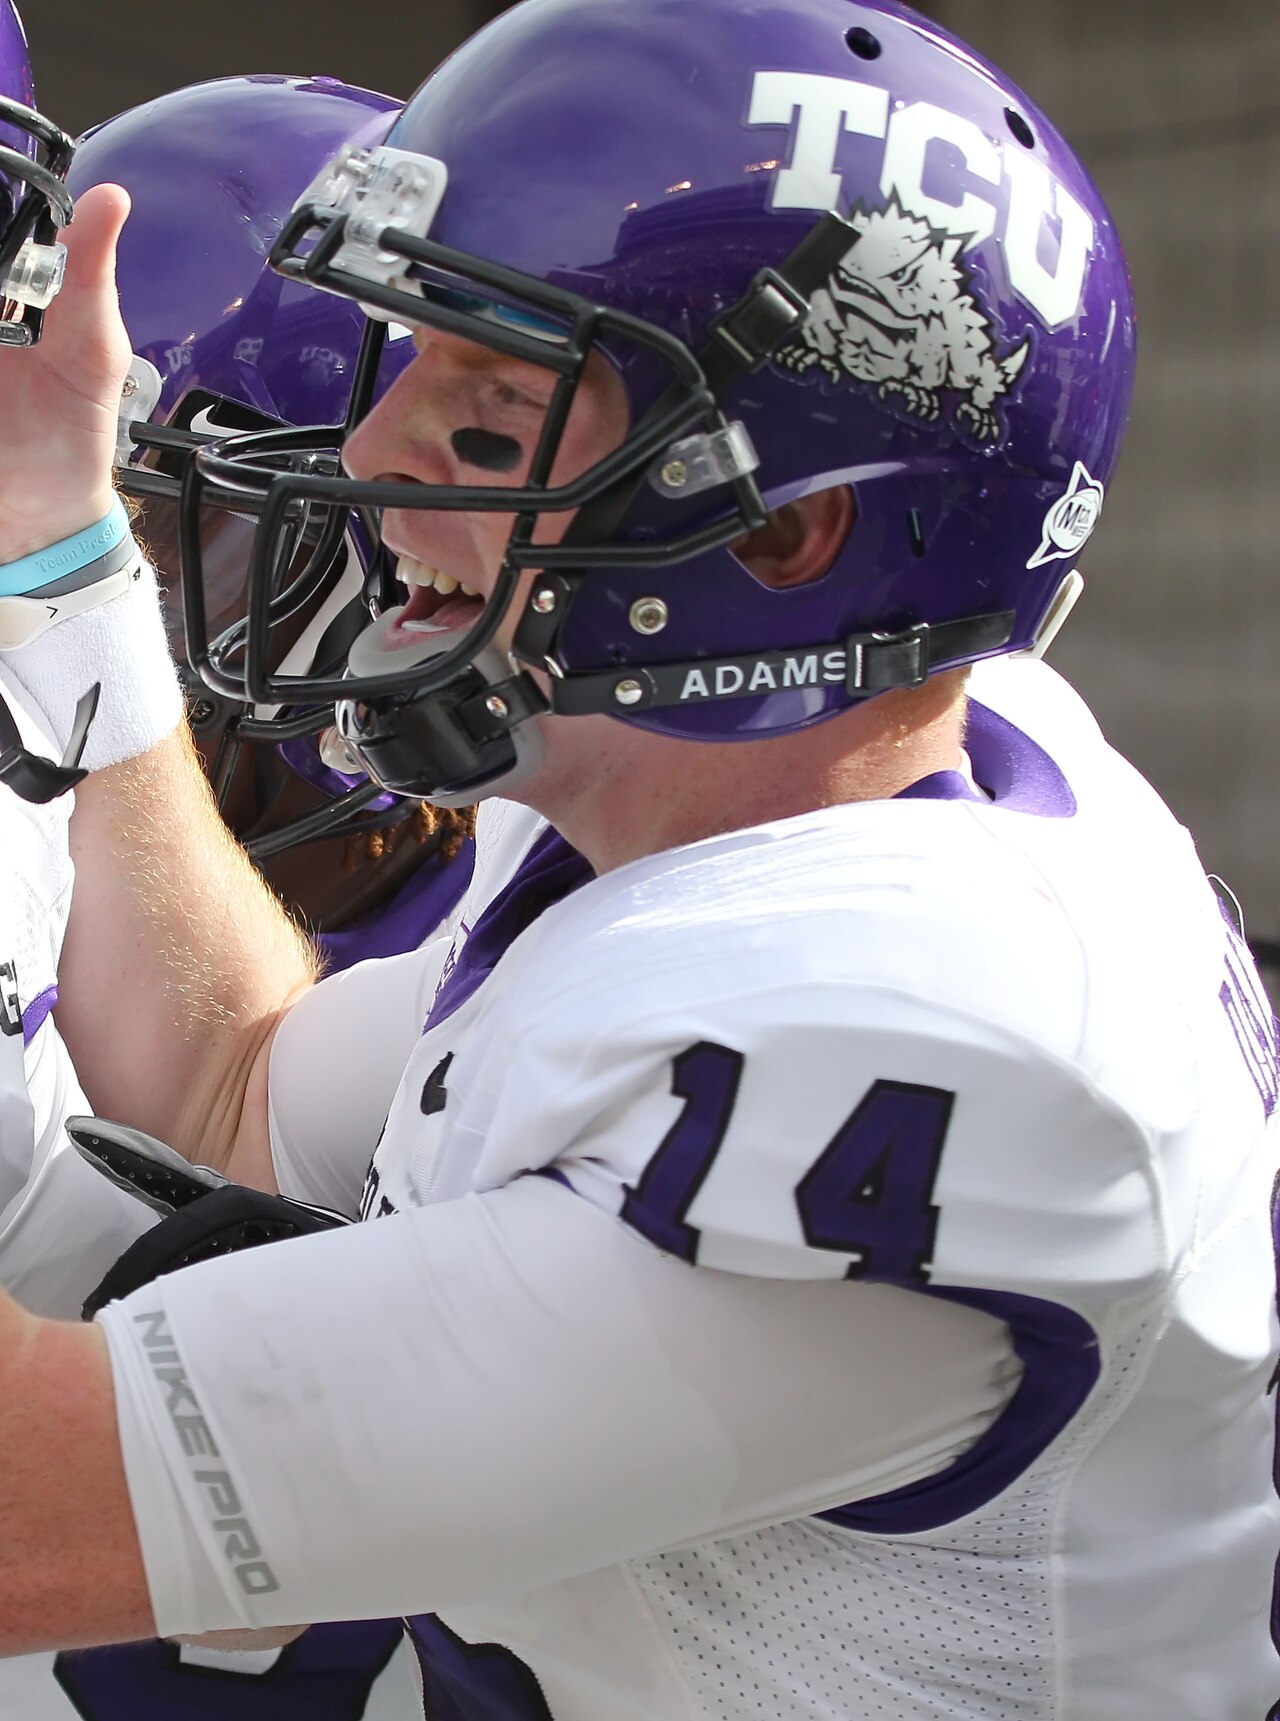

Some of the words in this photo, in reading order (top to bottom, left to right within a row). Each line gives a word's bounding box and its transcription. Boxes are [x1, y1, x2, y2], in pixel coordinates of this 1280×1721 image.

[748, 71, 1094, 327] TCU
[36, 549, 78, 573] Team
[680, 652, 847, 699] ADAMS
[619, 1041, 955, 1288] 14
[133, 1310, 220, 1457] NIKE
[193, 1470, 280, 1596] PRO
